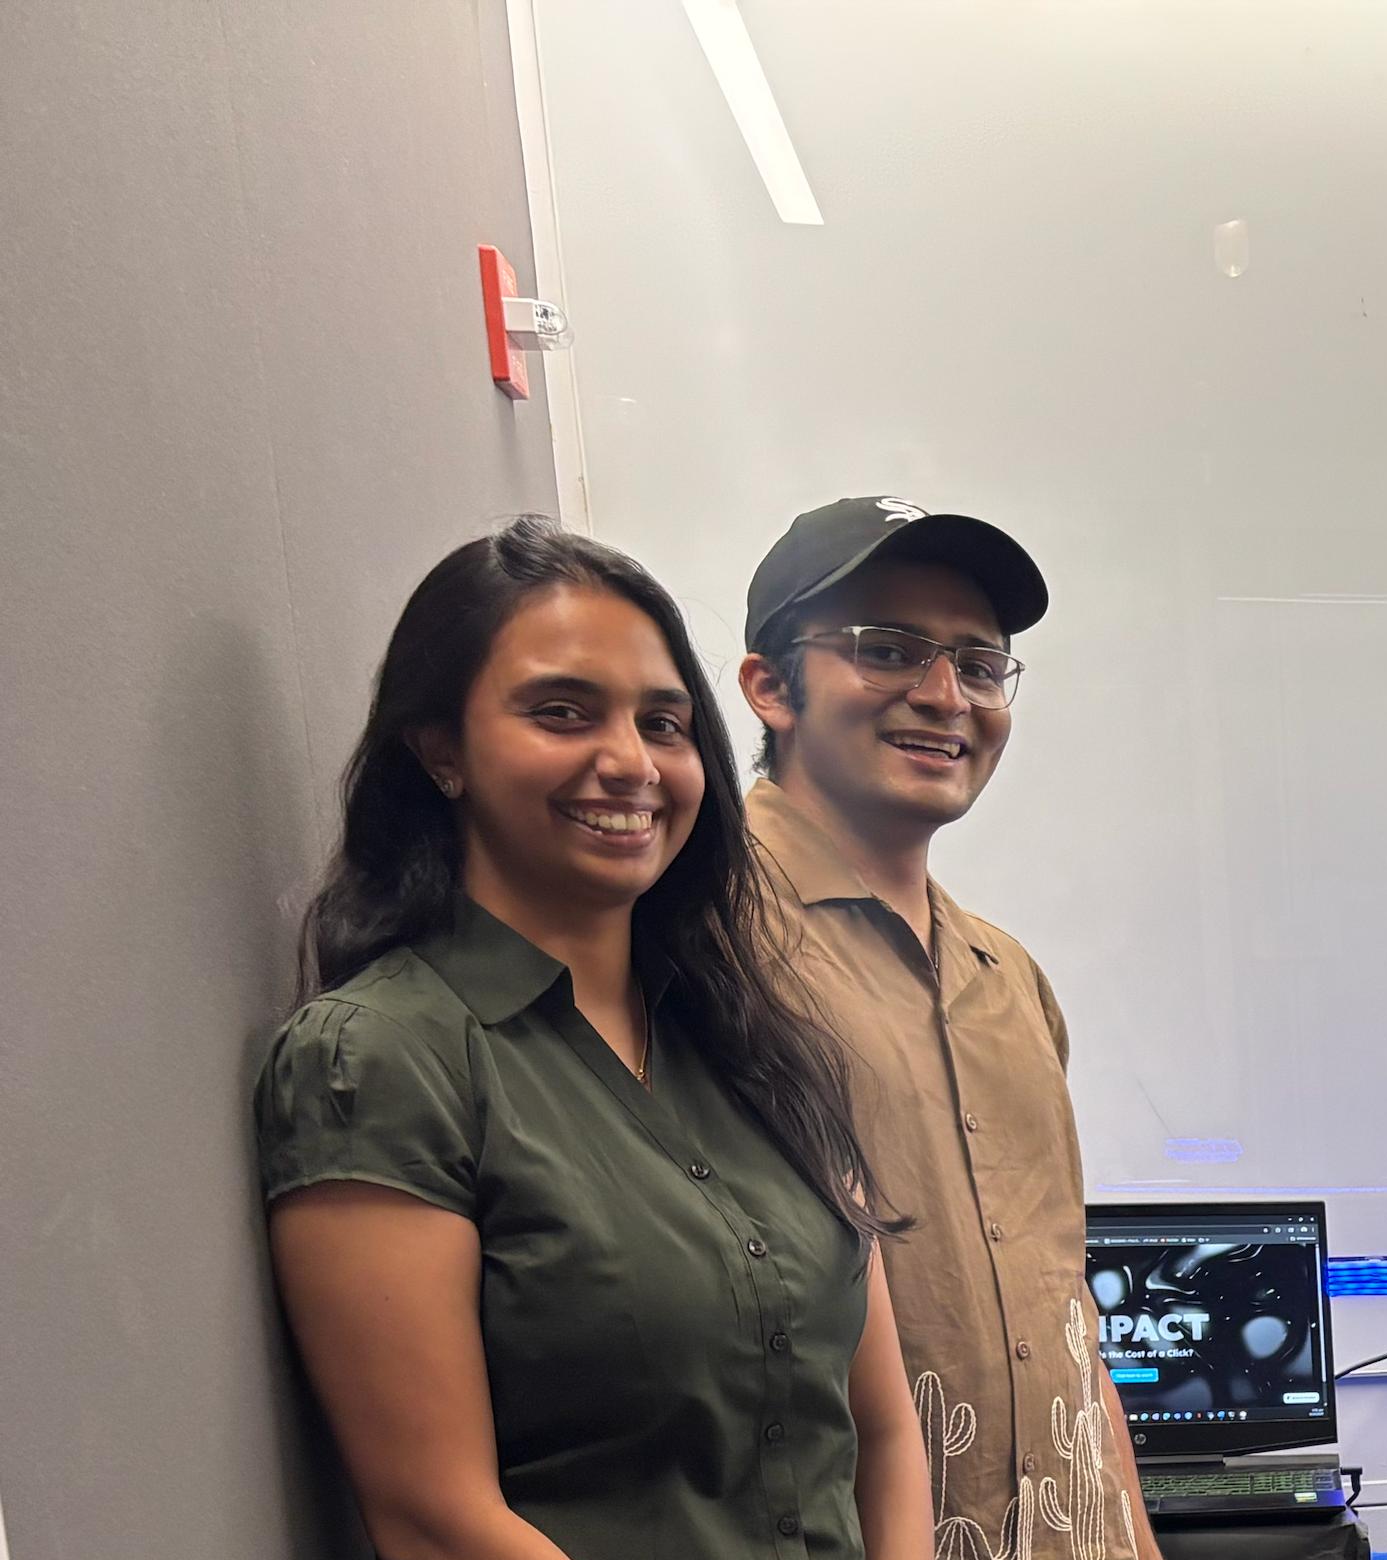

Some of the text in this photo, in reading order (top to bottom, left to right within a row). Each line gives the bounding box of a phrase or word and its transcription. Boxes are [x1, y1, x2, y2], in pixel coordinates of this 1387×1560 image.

[1108, 1350, 1123, 1359] the
[1125, 1350, 1145, 1358] Cost
[1147, 1350, 1157, 1358] of
[1167, 1348, 1194, 1358] Click?
